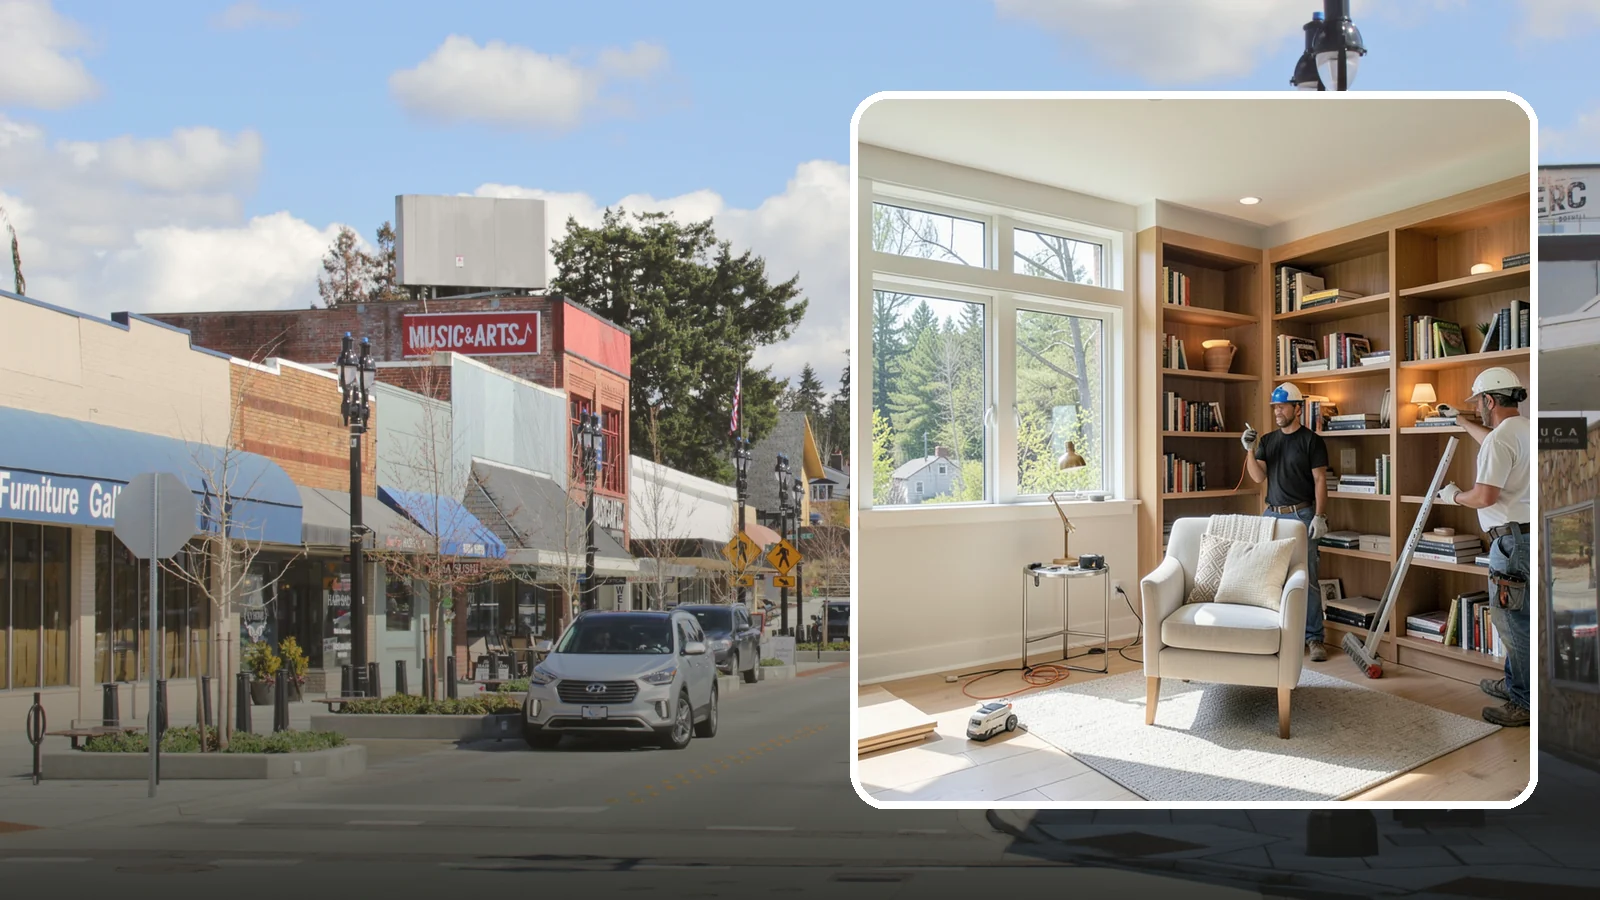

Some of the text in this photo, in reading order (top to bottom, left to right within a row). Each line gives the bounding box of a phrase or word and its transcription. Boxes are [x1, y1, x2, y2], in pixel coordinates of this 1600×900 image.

[1540, 427, 1578, 437] UGA
[0, 471, 80, 515] Furniture
[89, 482, 122, 519] Gal
[453, 563, 479, 574] SUSHI
